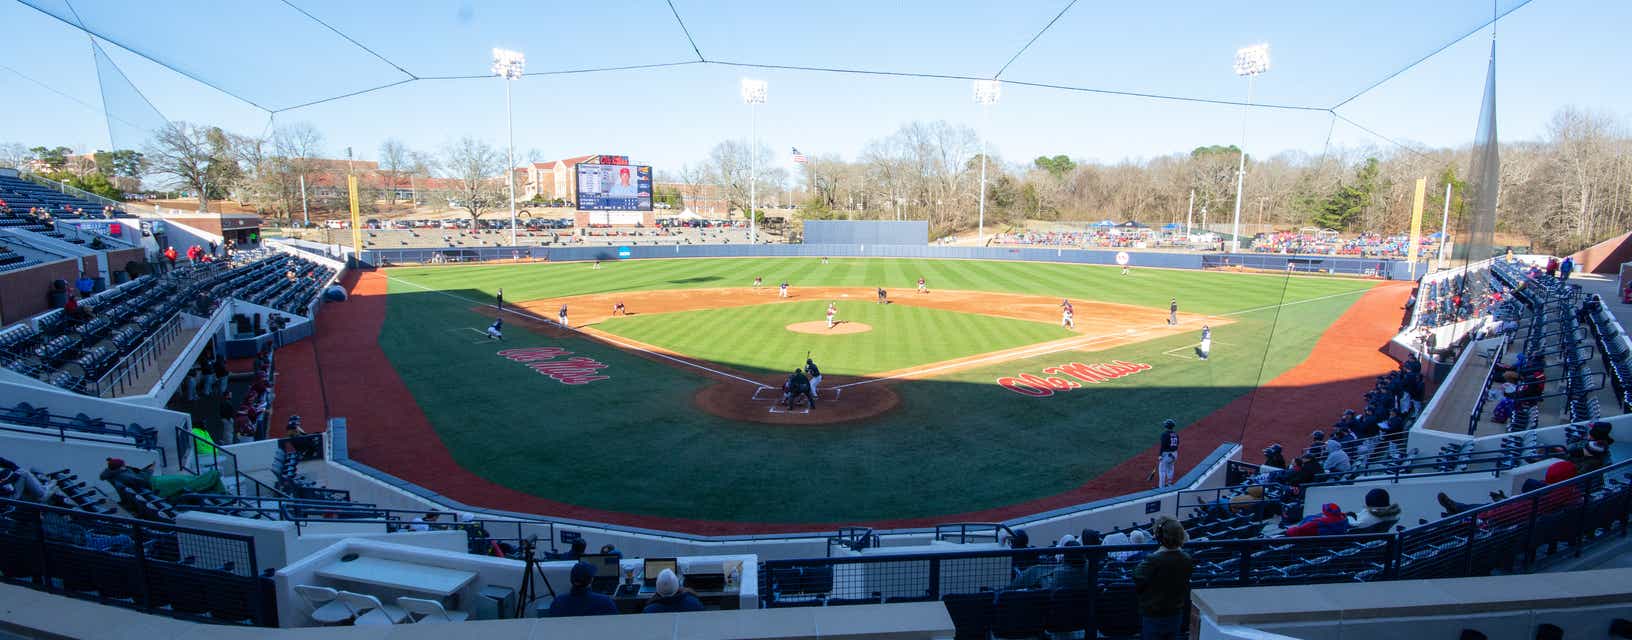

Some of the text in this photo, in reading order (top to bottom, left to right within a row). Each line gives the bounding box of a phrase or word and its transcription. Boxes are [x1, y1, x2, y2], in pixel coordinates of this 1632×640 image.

[496, 347, 610, 385] Ole Miss
[997, 359, 1153, 397] Ole Miss
